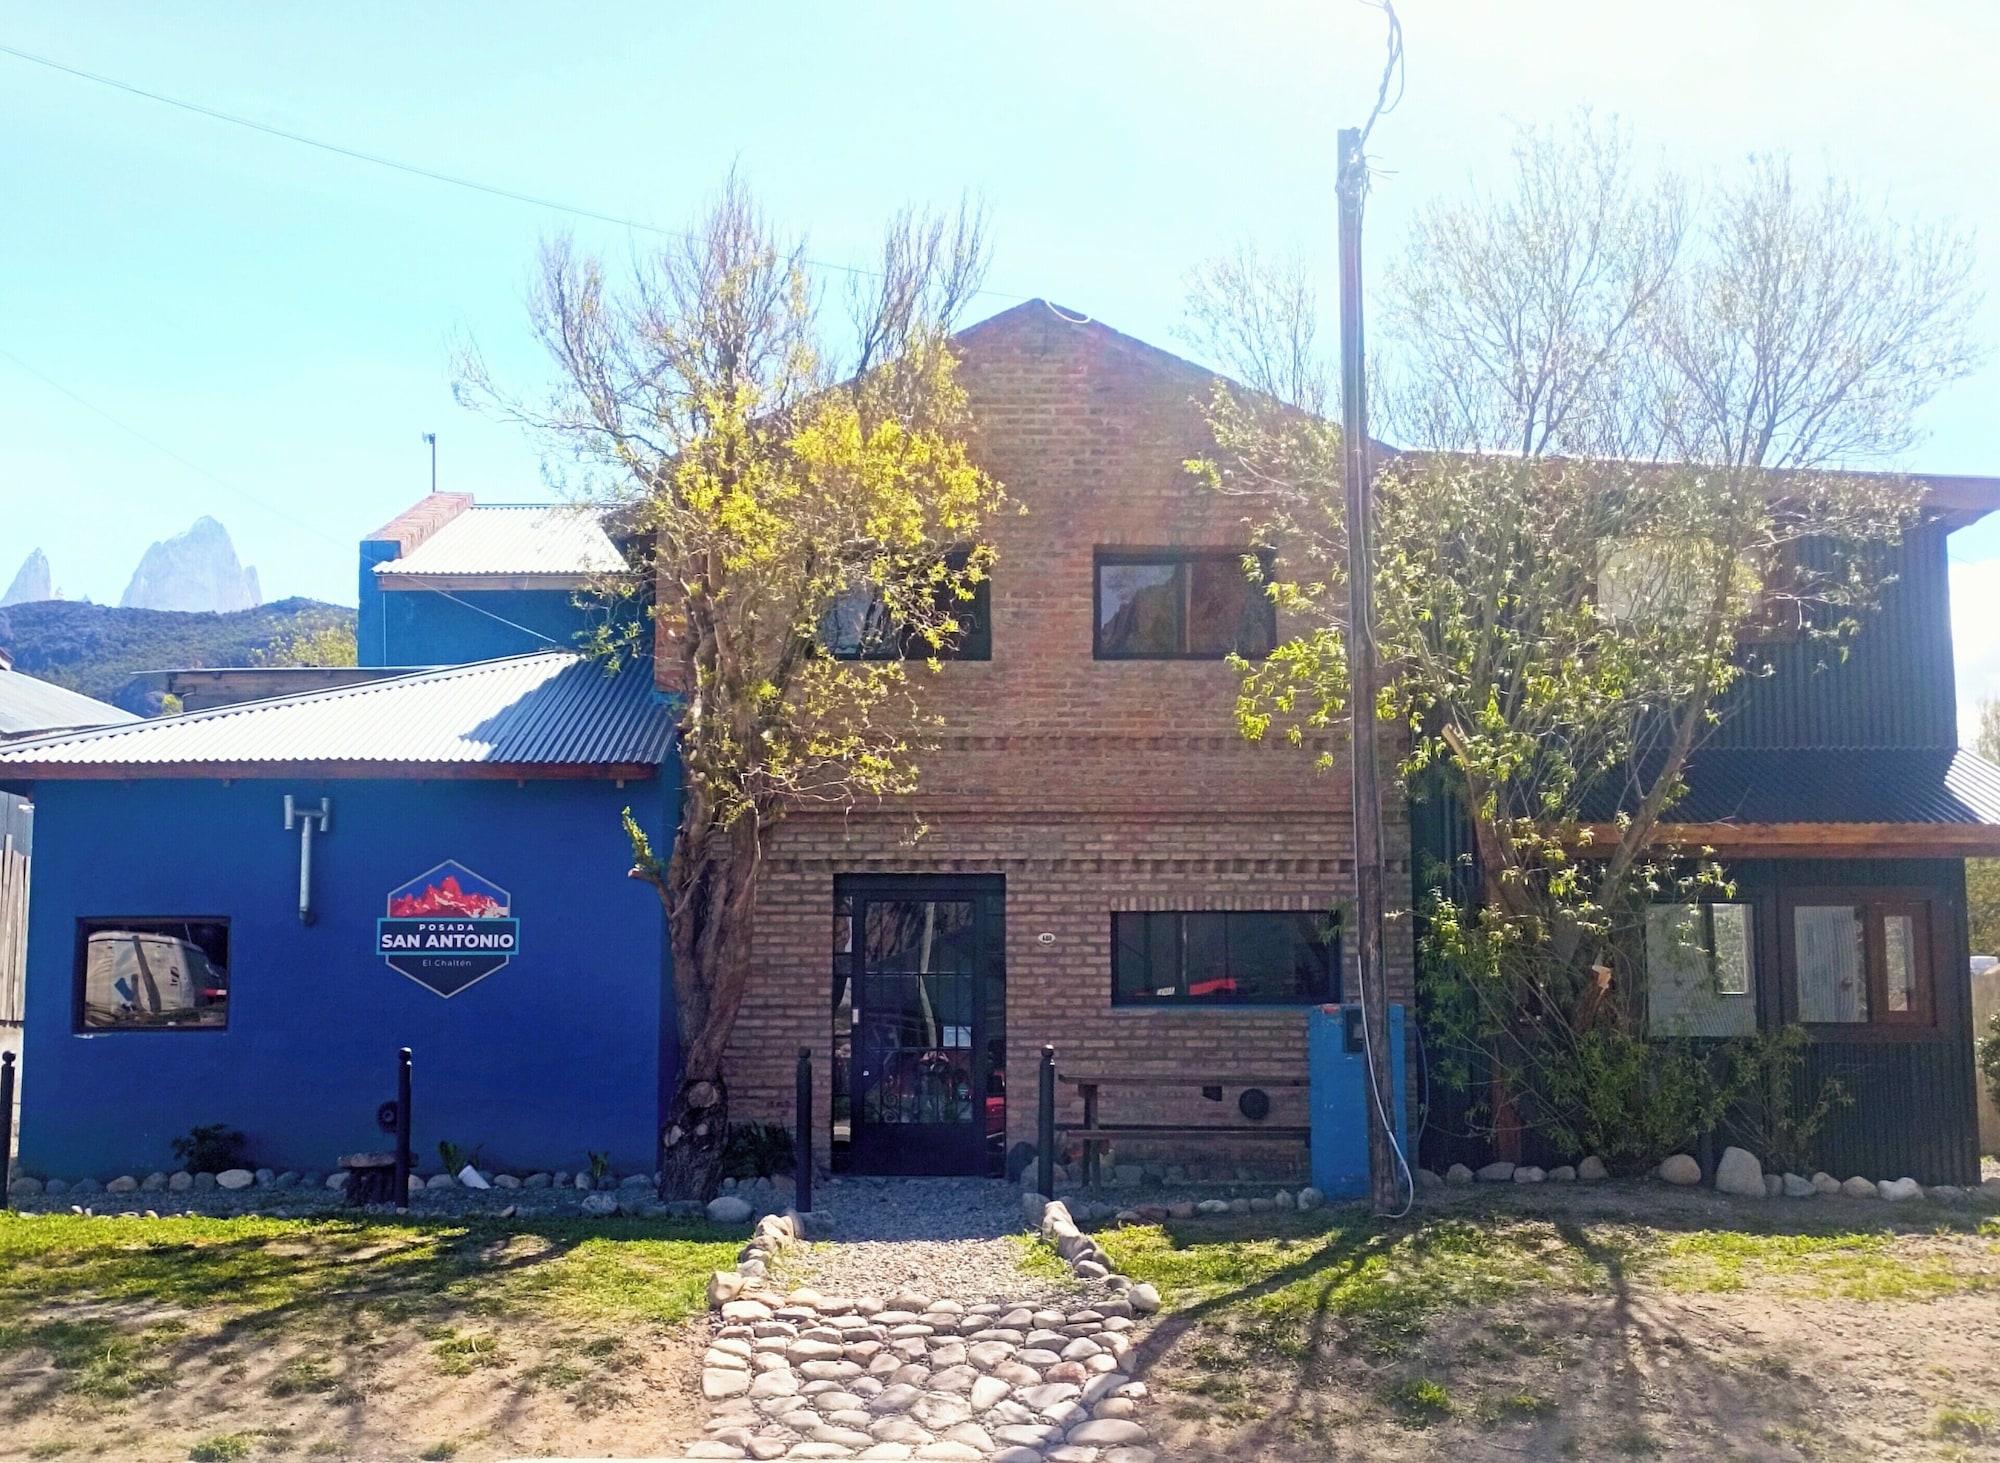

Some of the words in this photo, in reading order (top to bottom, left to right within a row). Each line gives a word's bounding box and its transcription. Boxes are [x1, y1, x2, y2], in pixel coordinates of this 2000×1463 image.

[382, 934, 420, 948] SAN
[426, 934, 514, 948] ANTONIO
[422, 959, 431, 967] El
